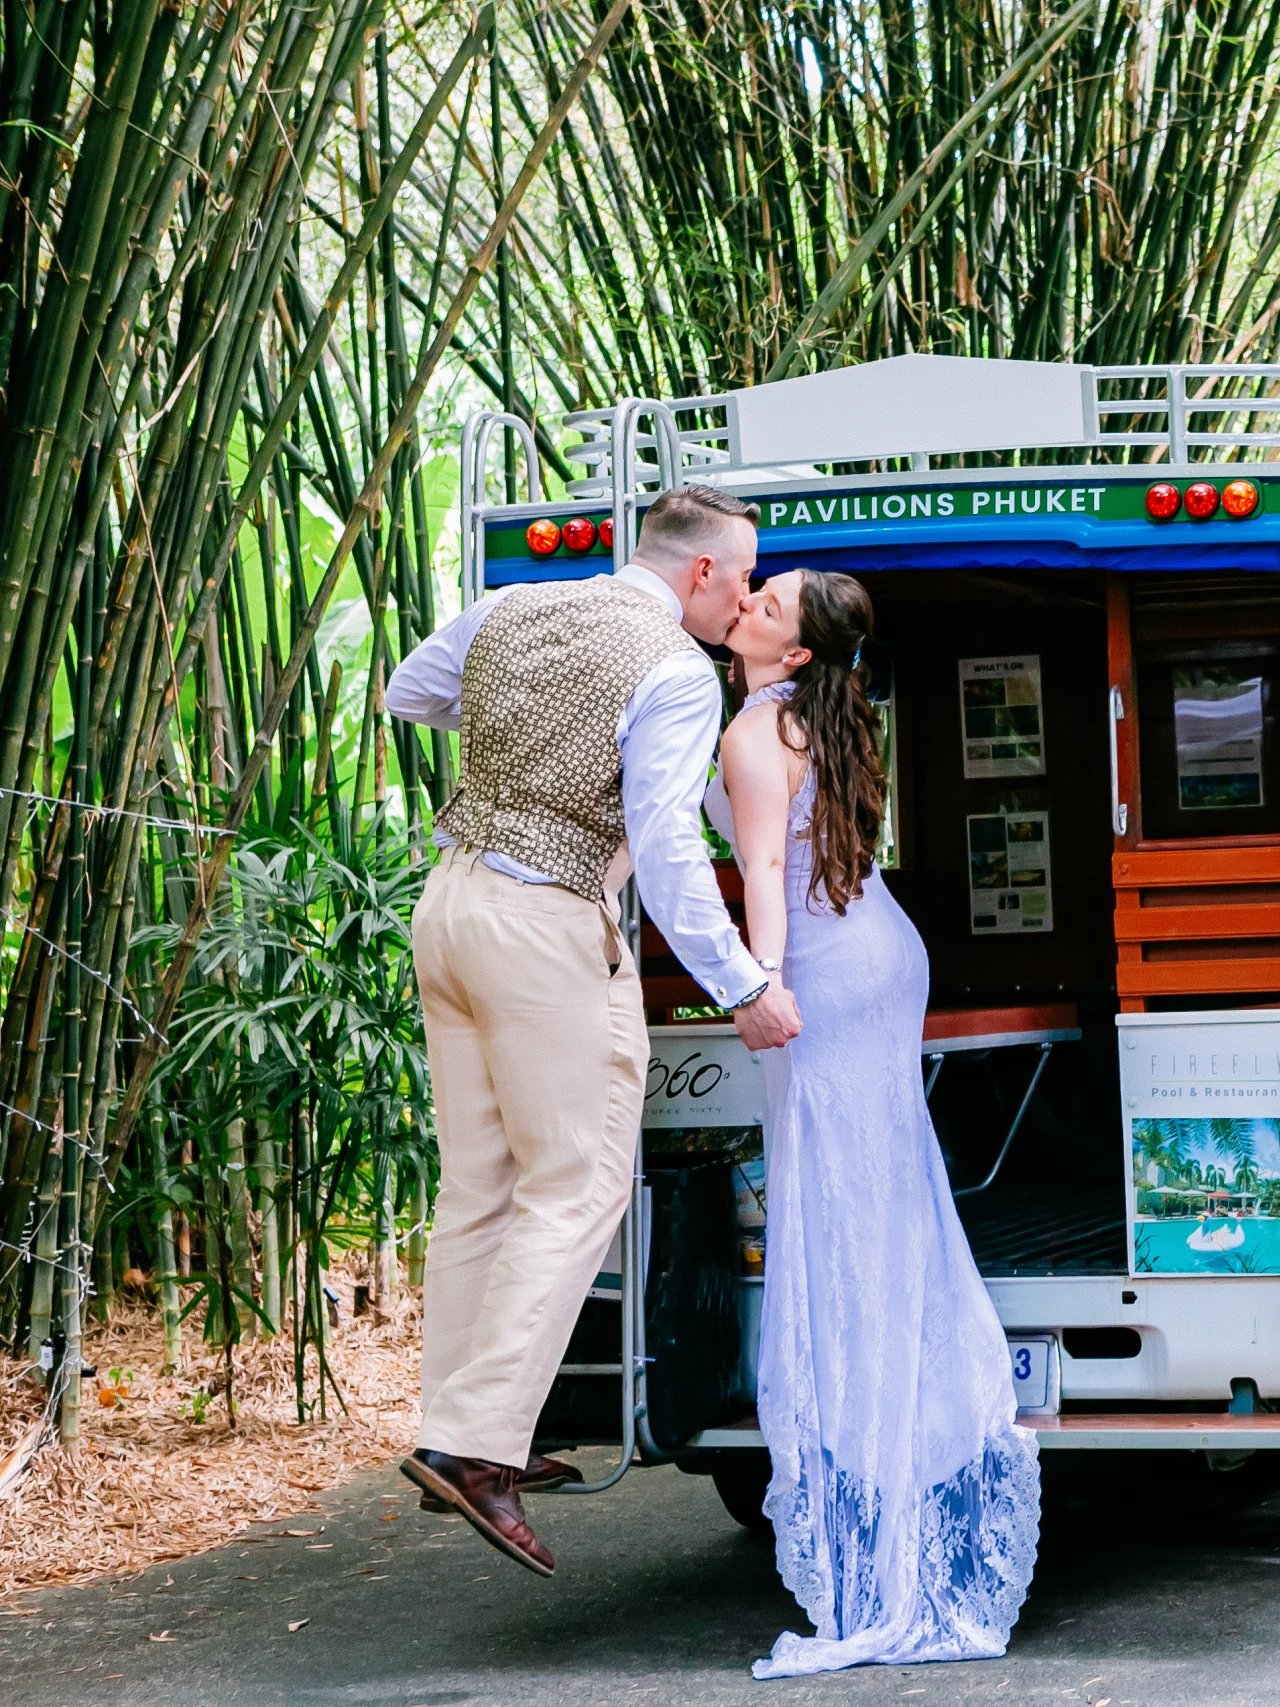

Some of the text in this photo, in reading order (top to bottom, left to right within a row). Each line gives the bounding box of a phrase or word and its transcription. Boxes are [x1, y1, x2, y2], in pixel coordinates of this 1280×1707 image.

[770, 487, 1106, 525] PAVILIONS PHUKET
[1151, 1087, 1182, 1098] Pool
[1189, 1087, 1198, 1098] &
[1014, 1348, 1031, 1380] 3
